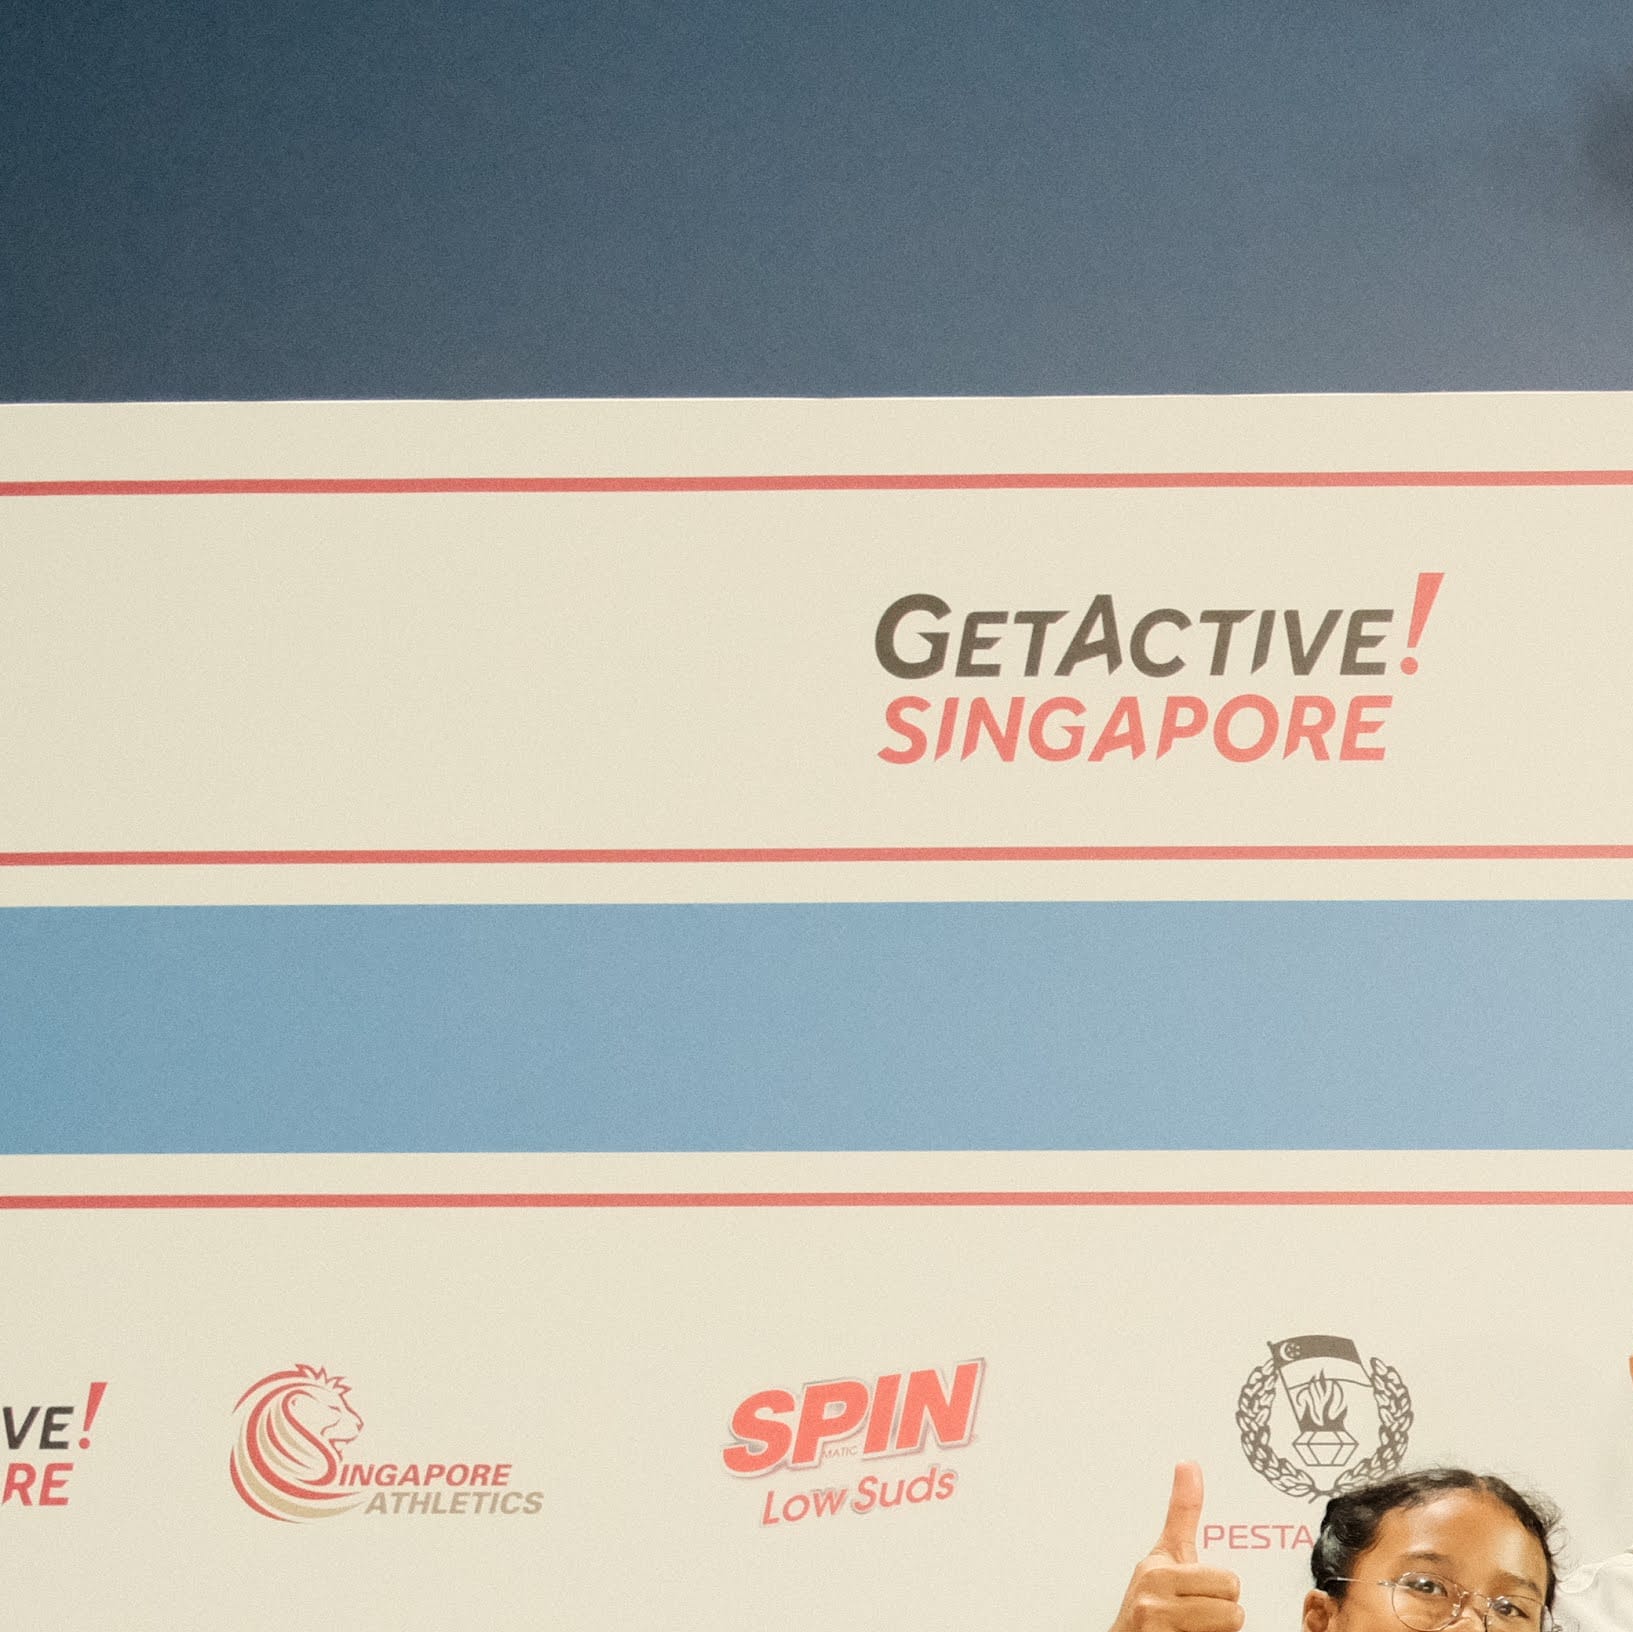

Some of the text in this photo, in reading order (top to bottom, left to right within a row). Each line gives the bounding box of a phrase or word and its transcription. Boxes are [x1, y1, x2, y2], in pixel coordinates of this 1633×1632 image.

[878, 694, 1393, 765] SINGAPORE
[721, 1360, 981, 1474] SPIN
[365, 1491, 543, 1515] ATHLETICS
[762, 1465, 956, 1526] Low Suds
[1203, 1524, 1316, 1549] PESTA
